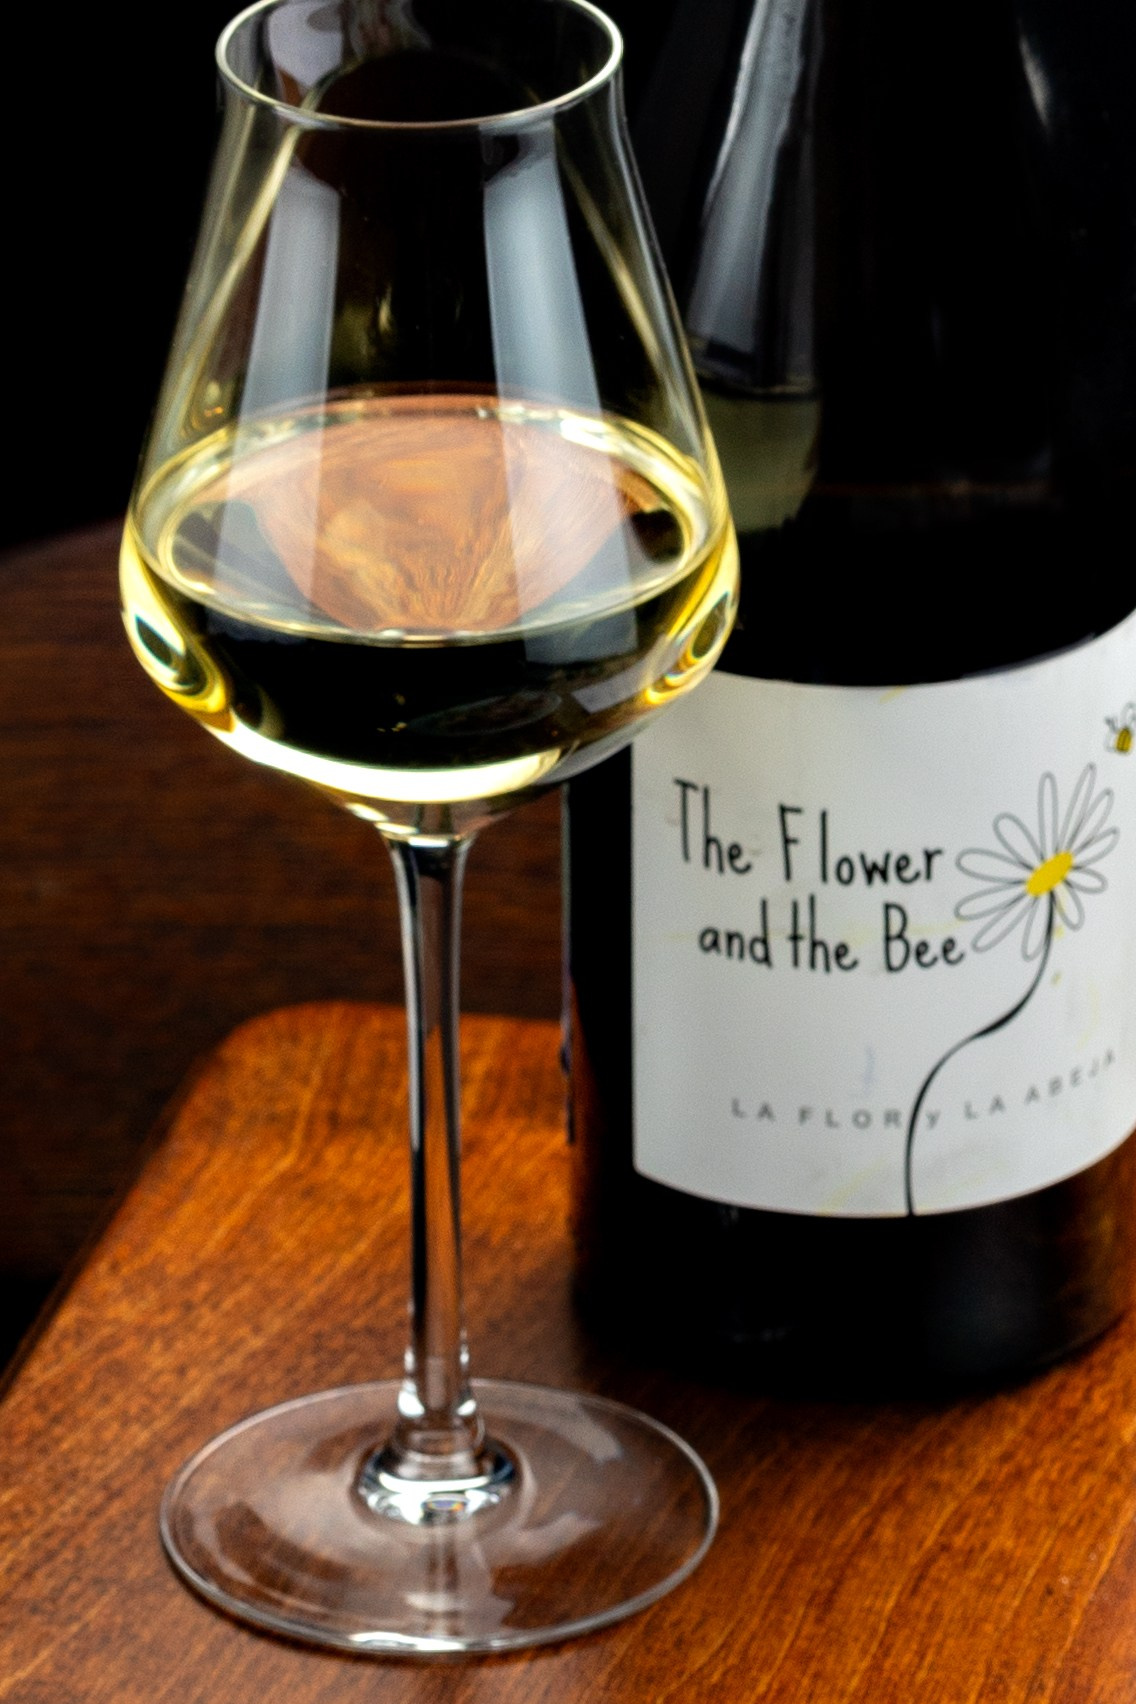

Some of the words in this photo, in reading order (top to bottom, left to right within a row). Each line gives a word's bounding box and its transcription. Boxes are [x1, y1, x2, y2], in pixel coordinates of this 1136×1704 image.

[675, 778, 752, 876] The
[778, 803, 943, 886] Flower
[699, 897, 772, 968] and
[786, 893, 858, 974] the
[883, 902, 965, 974] Bee
[730, 1098, 776, 1123] LA
[798, 1107, 903, 1130] FLOR
[964, 1094, 1007, 1121] LA
[1025, 1048, 1118, 1107] ABEJA
